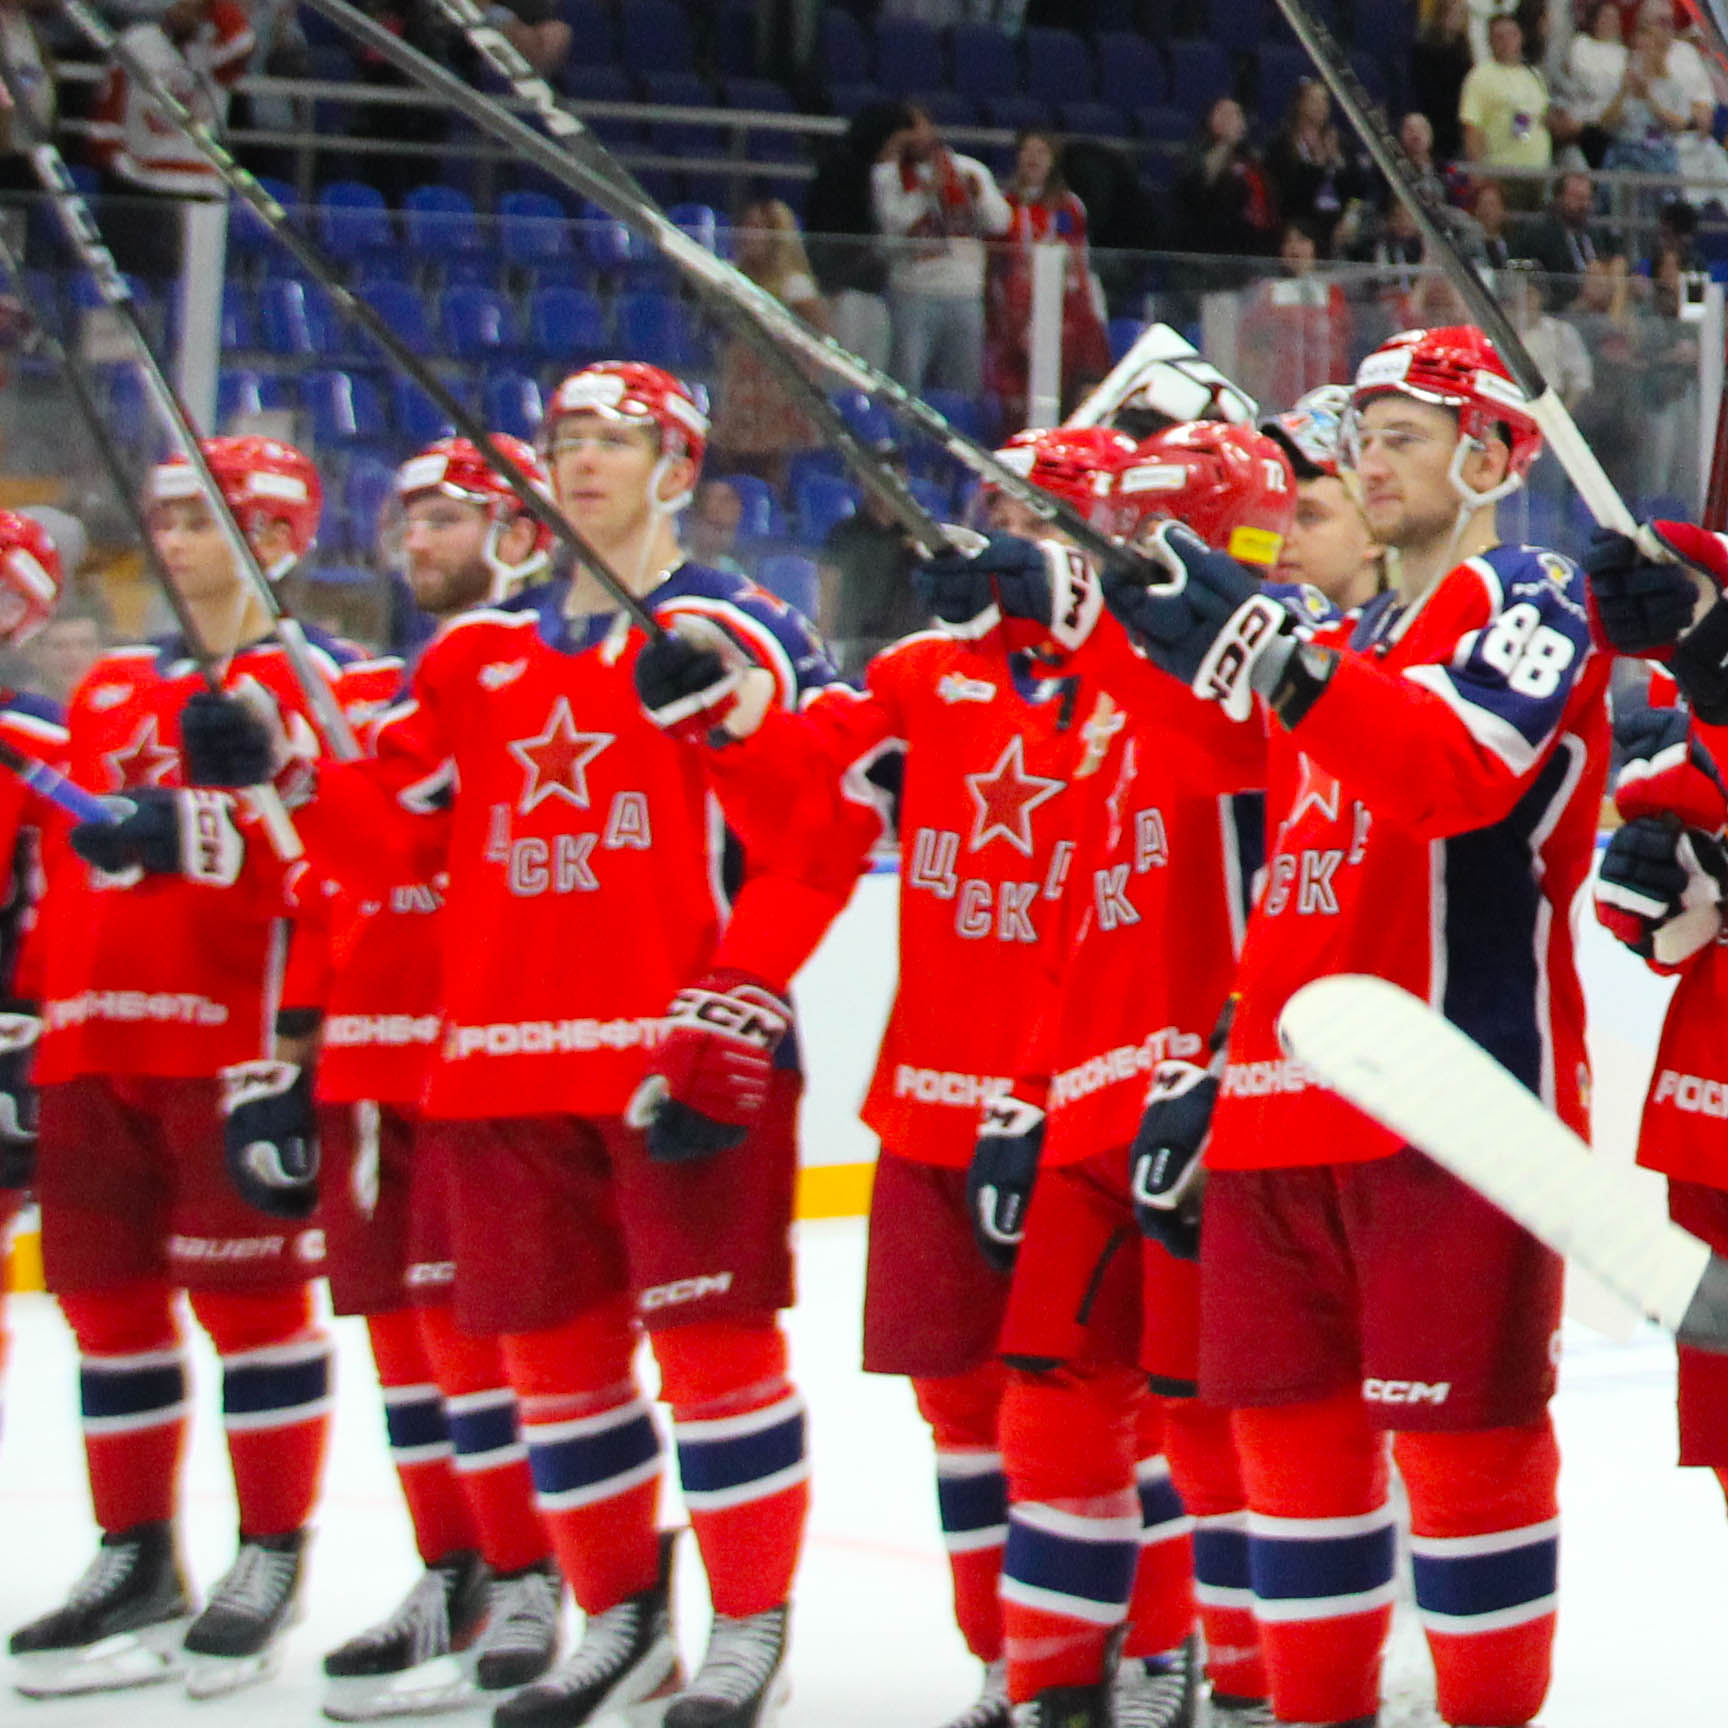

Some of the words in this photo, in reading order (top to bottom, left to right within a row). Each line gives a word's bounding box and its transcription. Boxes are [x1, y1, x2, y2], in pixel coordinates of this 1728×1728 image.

[1480, 603, 1577, 699] 88
[1095, 806, 1169, 932] КА
[895, 1064, 1014, 1107] РОСНЕ
[640, 1272, 735, 1312] CCM
[1362, 1378, 1452, 1405] CCM
